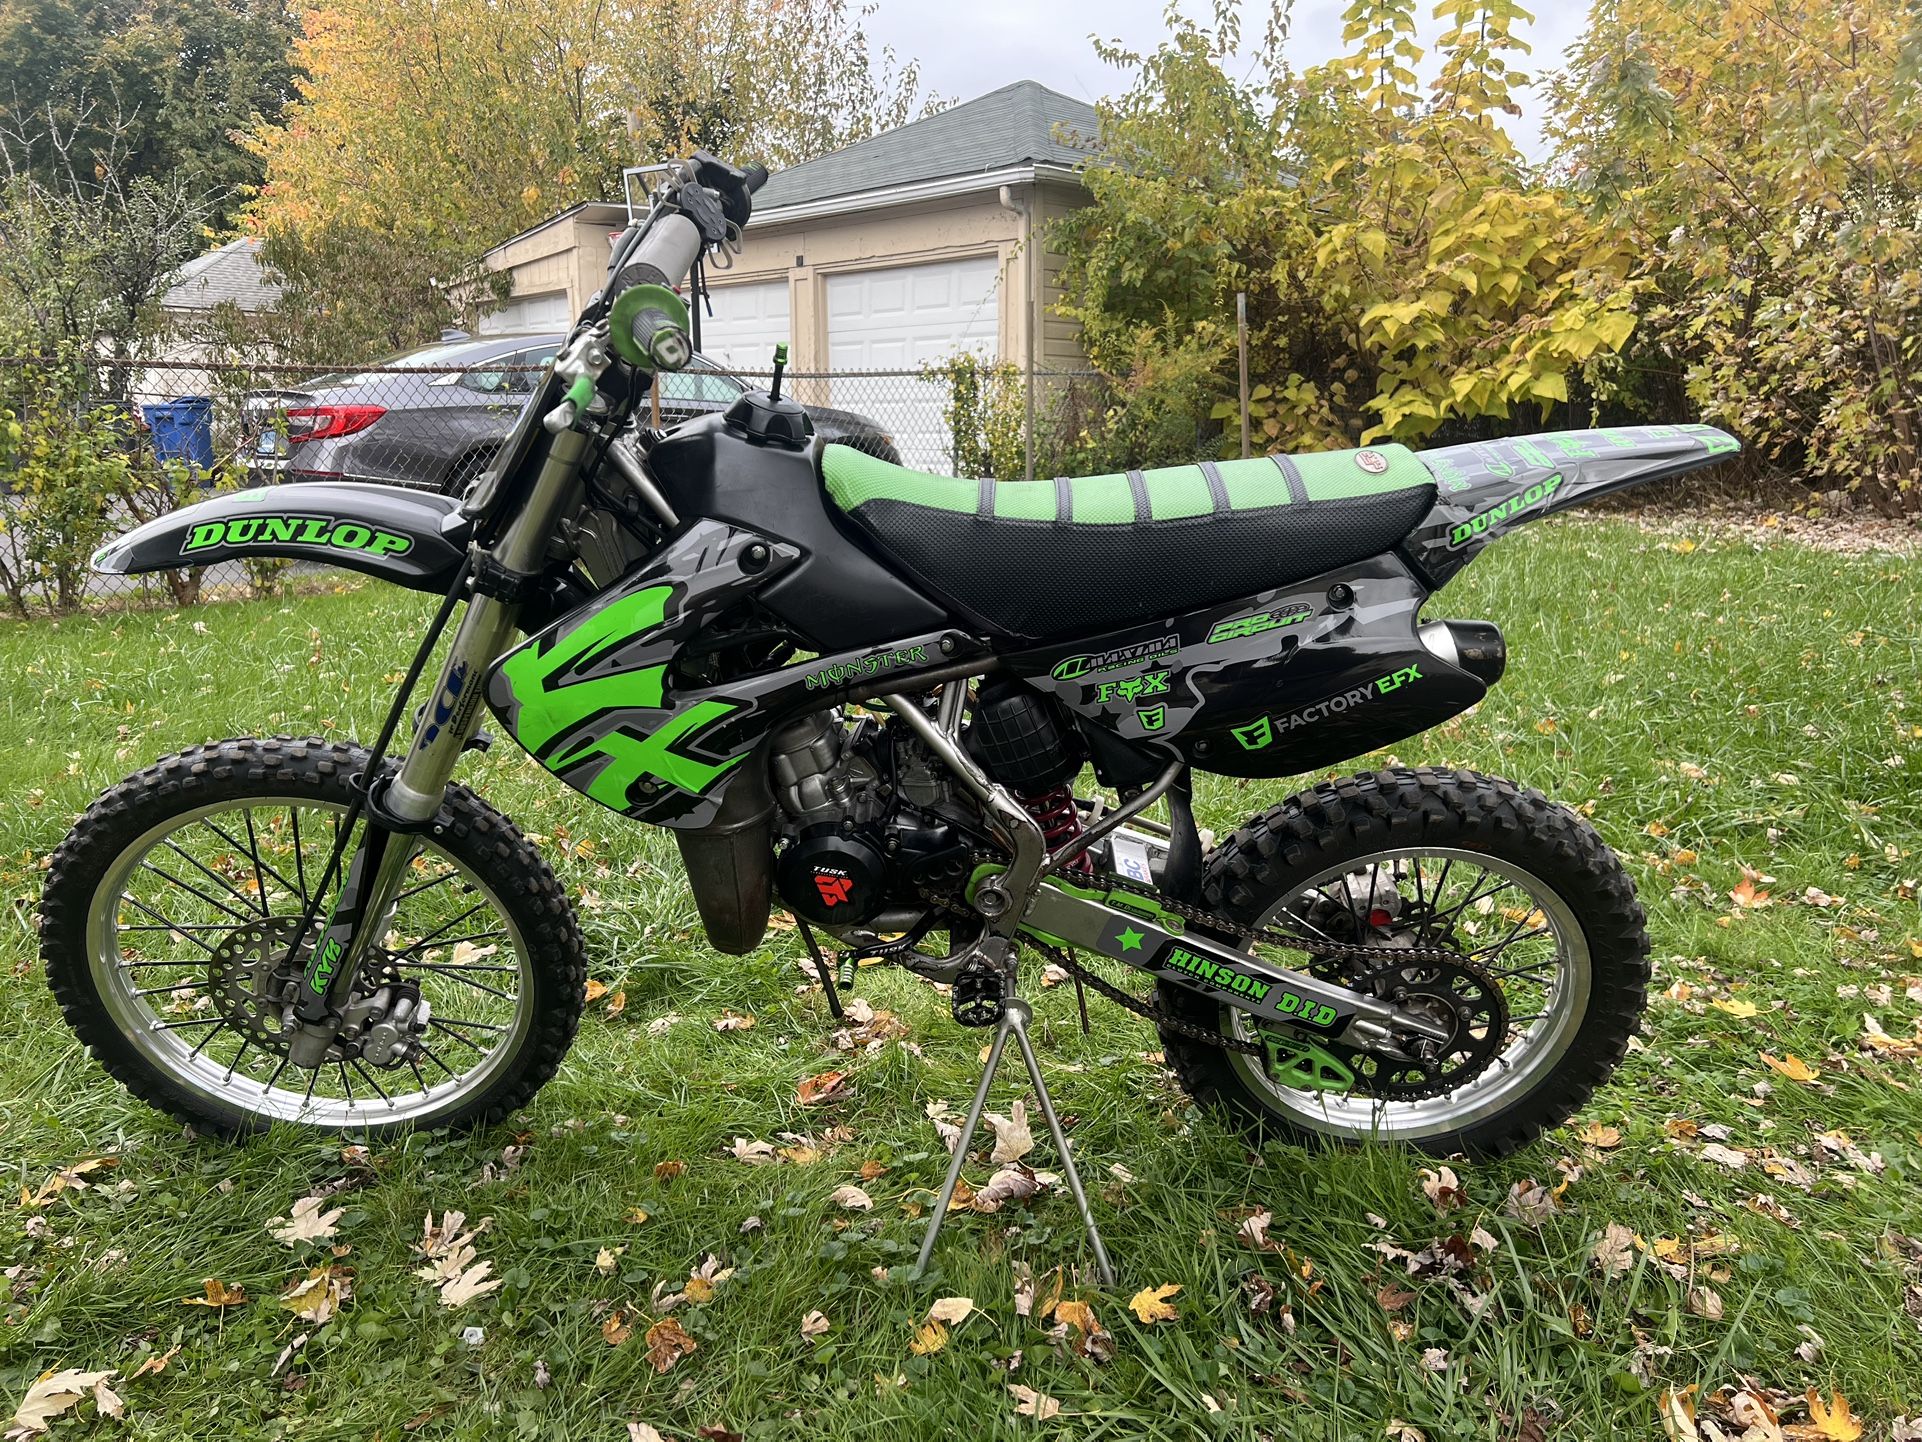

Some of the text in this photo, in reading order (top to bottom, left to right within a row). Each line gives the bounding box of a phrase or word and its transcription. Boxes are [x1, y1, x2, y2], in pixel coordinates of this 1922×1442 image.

[1452, 473, 1563, 545] DUNLOP
[186, 518, 411, 556] DUNLOP
[1208, 609, 1314, 644] CIRCUIT
[805, 645, 928, 689] MONSTER
[1096, 648, 1179, 673] RACING OILS
[813, 865, 848, 876] TUSK
[310, 937, 342, 995] KYB
[870, 944, 906, 956] TUSK
[1166, 963, 1262, 1004] CLUTCH COMPONENTS
[1169, 948, 1272, 1000] HINSON
[1276, 992, 1338, 1026] D.I.D
